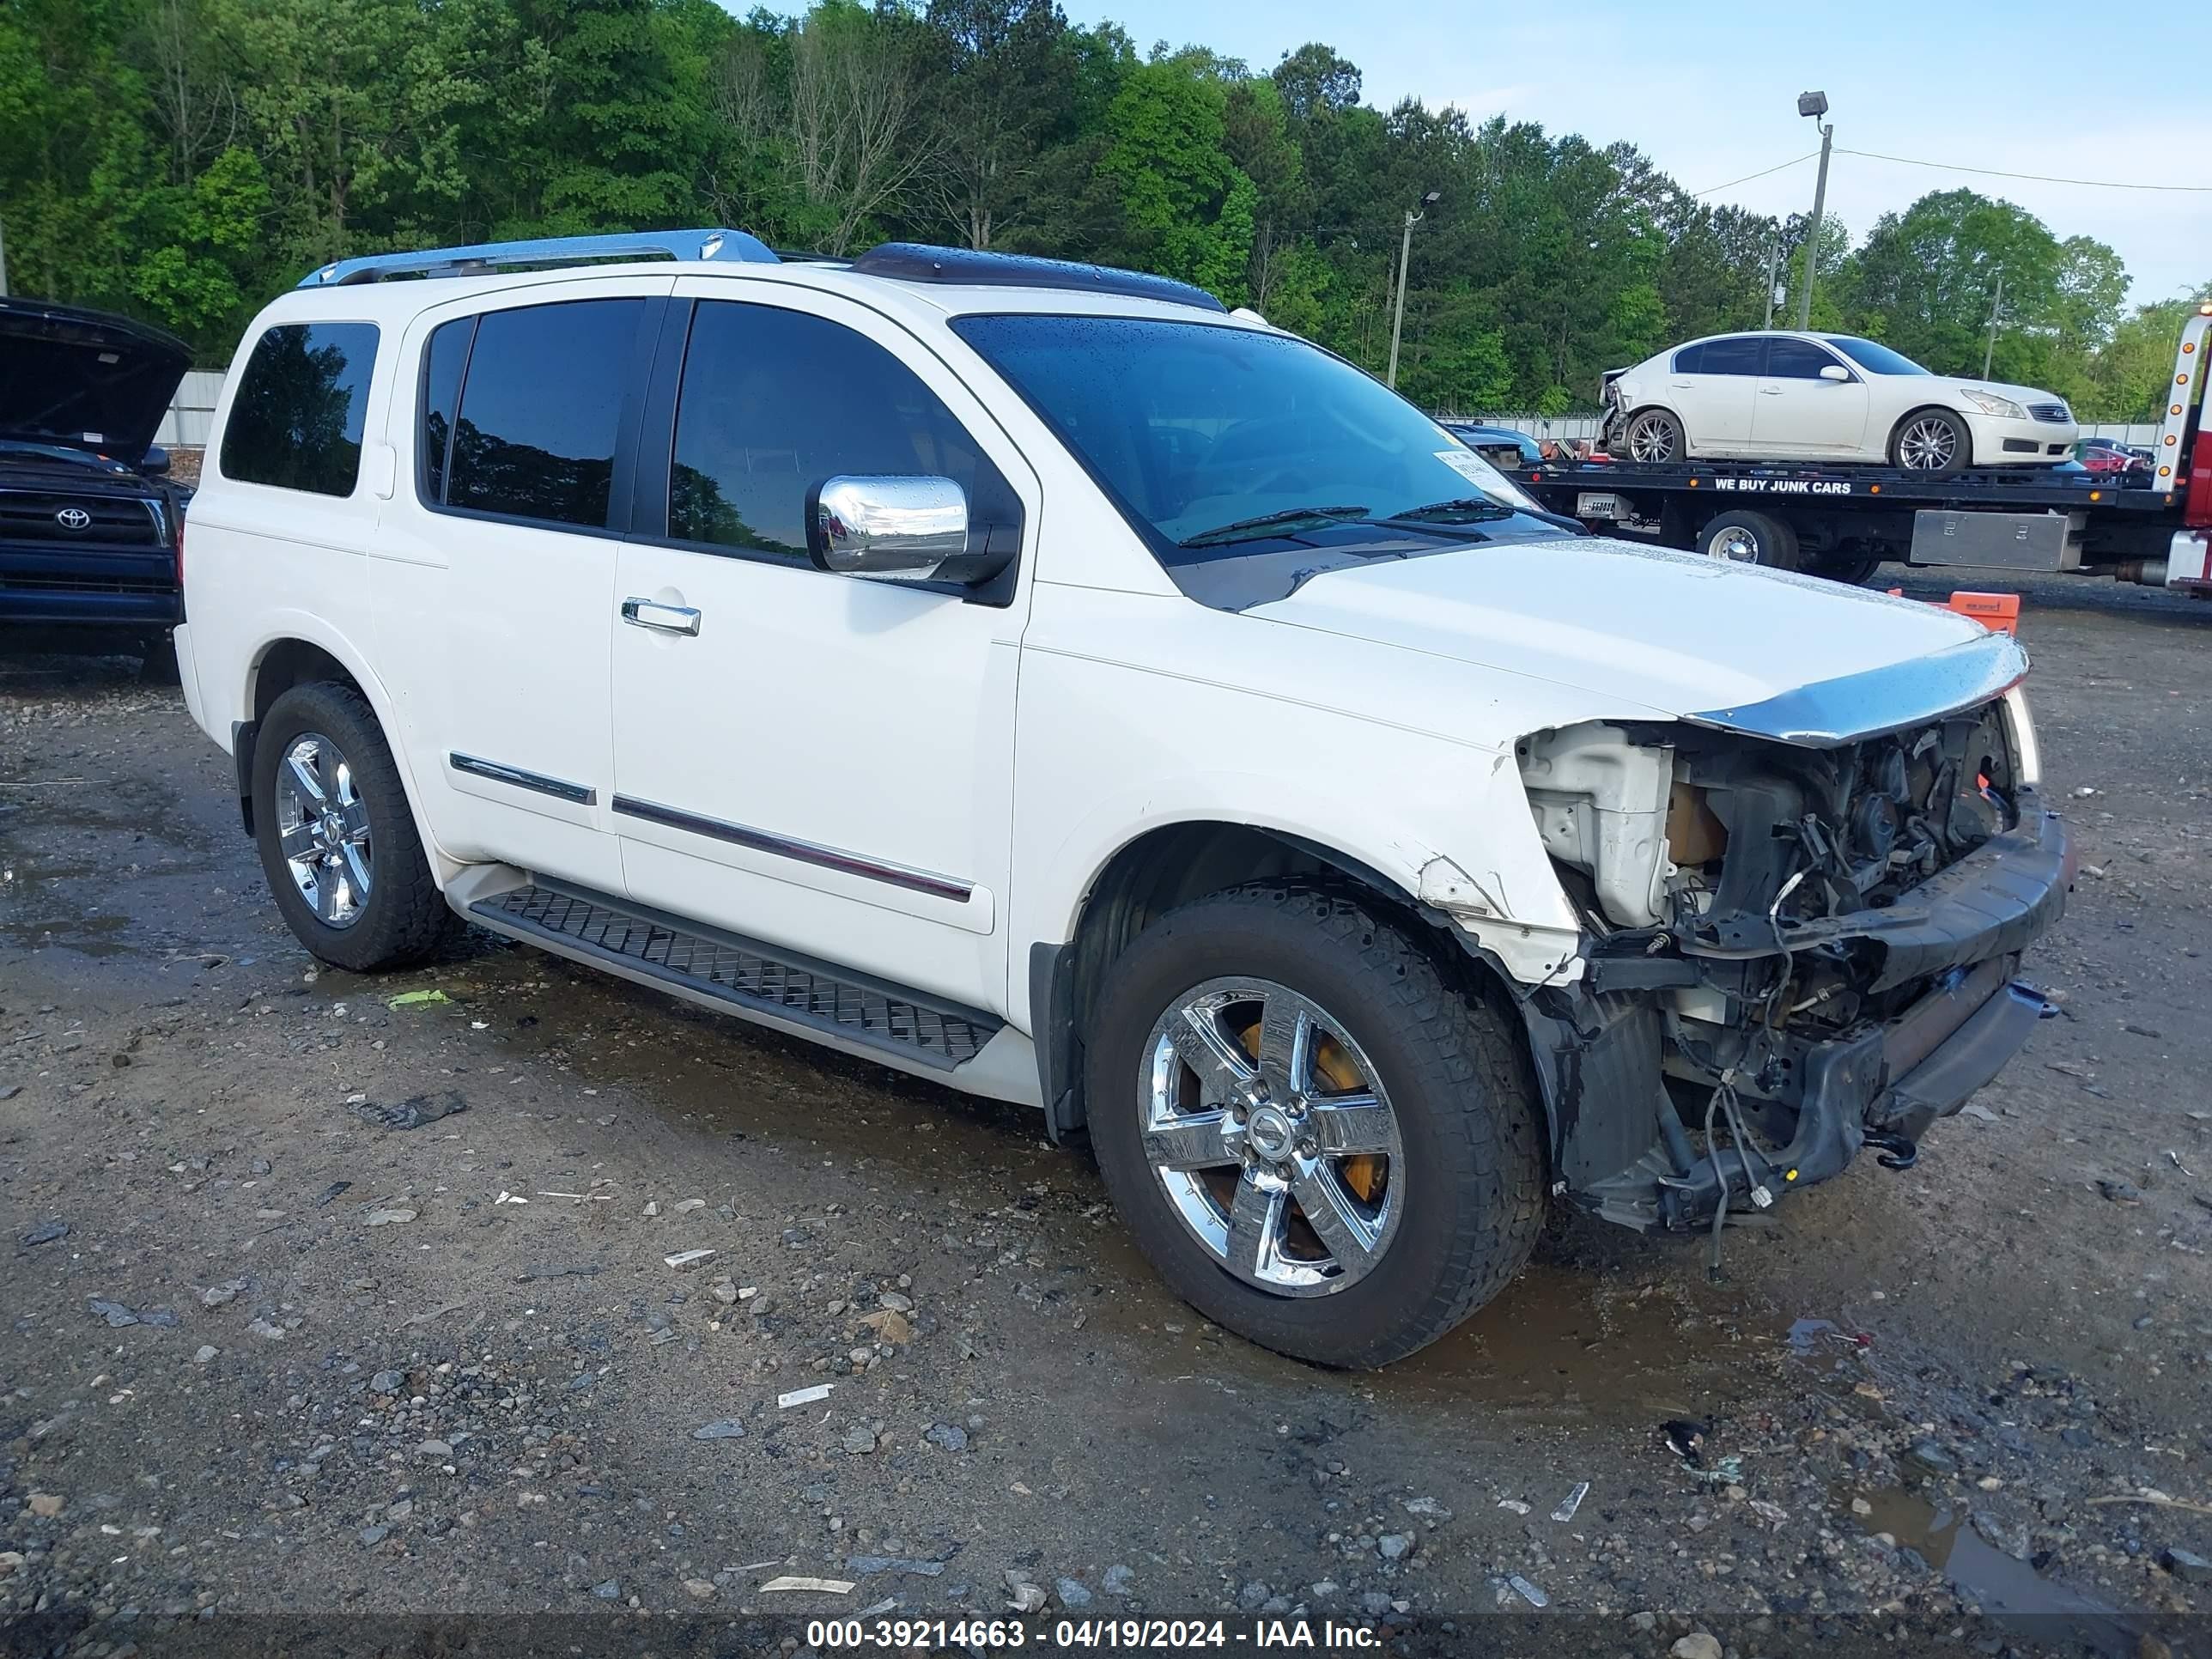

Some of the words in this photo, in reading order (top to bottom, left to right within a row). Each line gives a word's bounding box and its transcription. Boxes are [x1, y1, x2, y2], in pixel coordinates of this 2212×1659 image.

[1716, 478, 1735, 490] WE
[1739, 479, 1768, 491] BUY
[1770, 480, 1809, 493] JUNK
[1812, 482, 1851, 495] CARS
